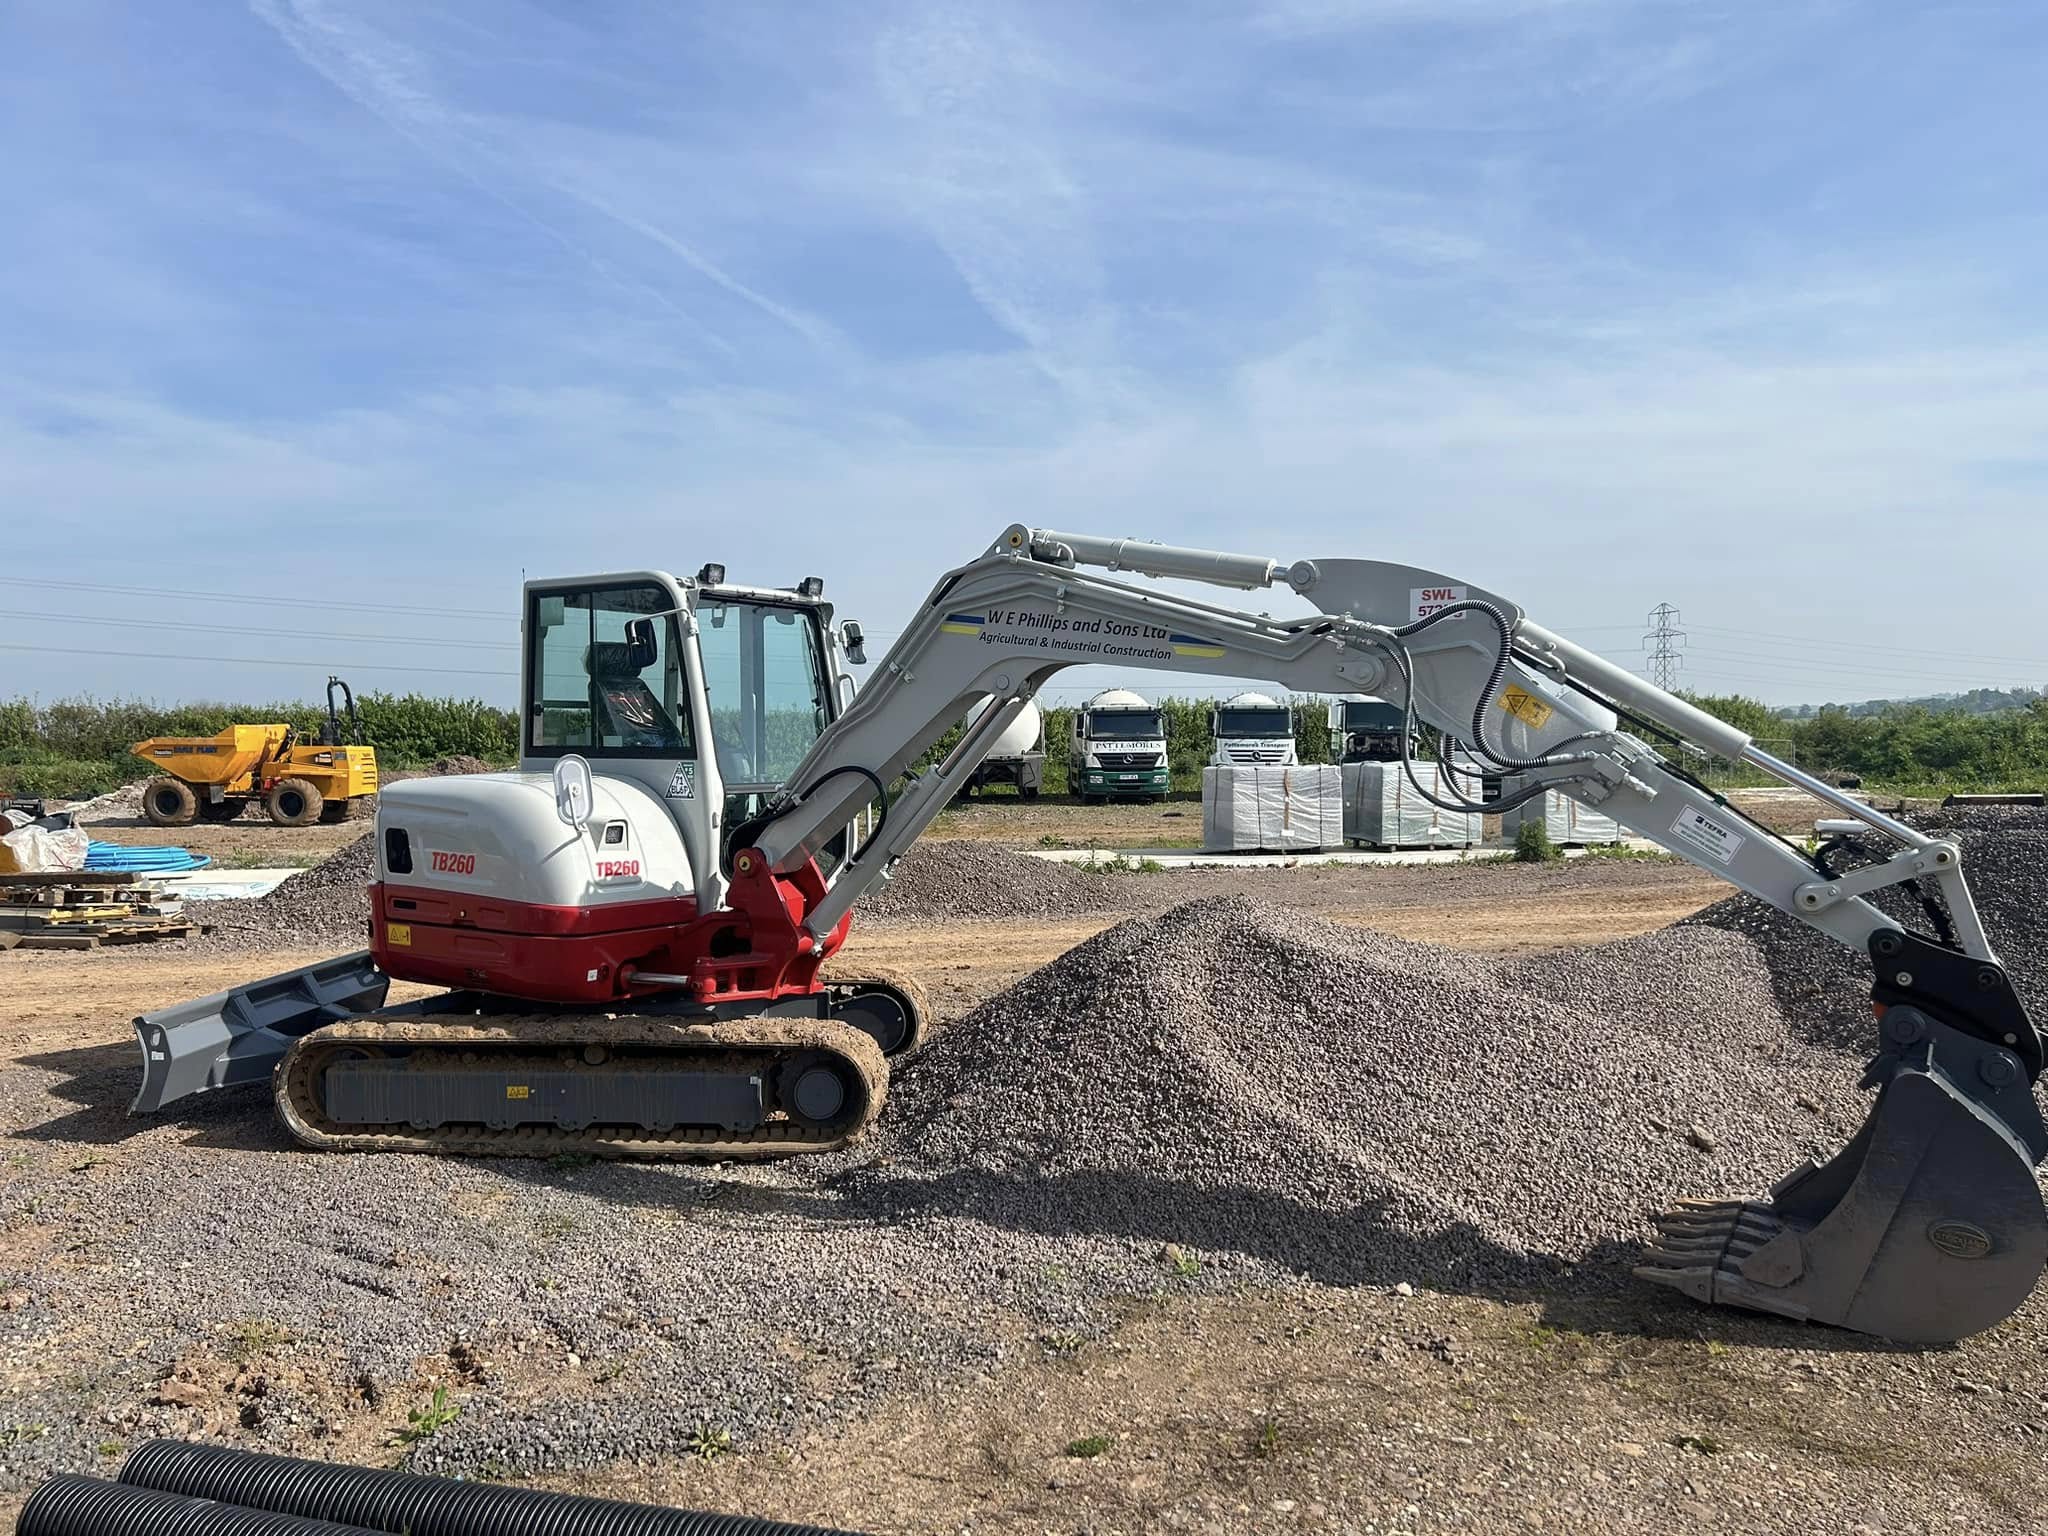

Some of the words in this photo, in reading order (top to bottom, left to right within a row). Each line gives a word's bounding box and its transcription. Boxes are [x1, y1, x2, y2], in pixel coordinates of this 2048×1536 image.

[1422, 589, 1456, 601] SWL
[988, 609, 1004, 624] W
[1006, 611, 1015, 625] E
[1018, 612, 1070, 633] Phillips
[1072, 618, 1102, 633] and
[1104, 619, 1139, 637] Sons
[1143, 622, 1169, 639] Ltd
[979, 631, 1039, 647] Agricultural
[1040, 637, 1049, 648] &
[1051, 638, 1101, 653] Industrial
[1103, 643, 1172, 660] Construction
[432, 852, 475, 874] TB260
[596, 860, 640, 876] TB260
